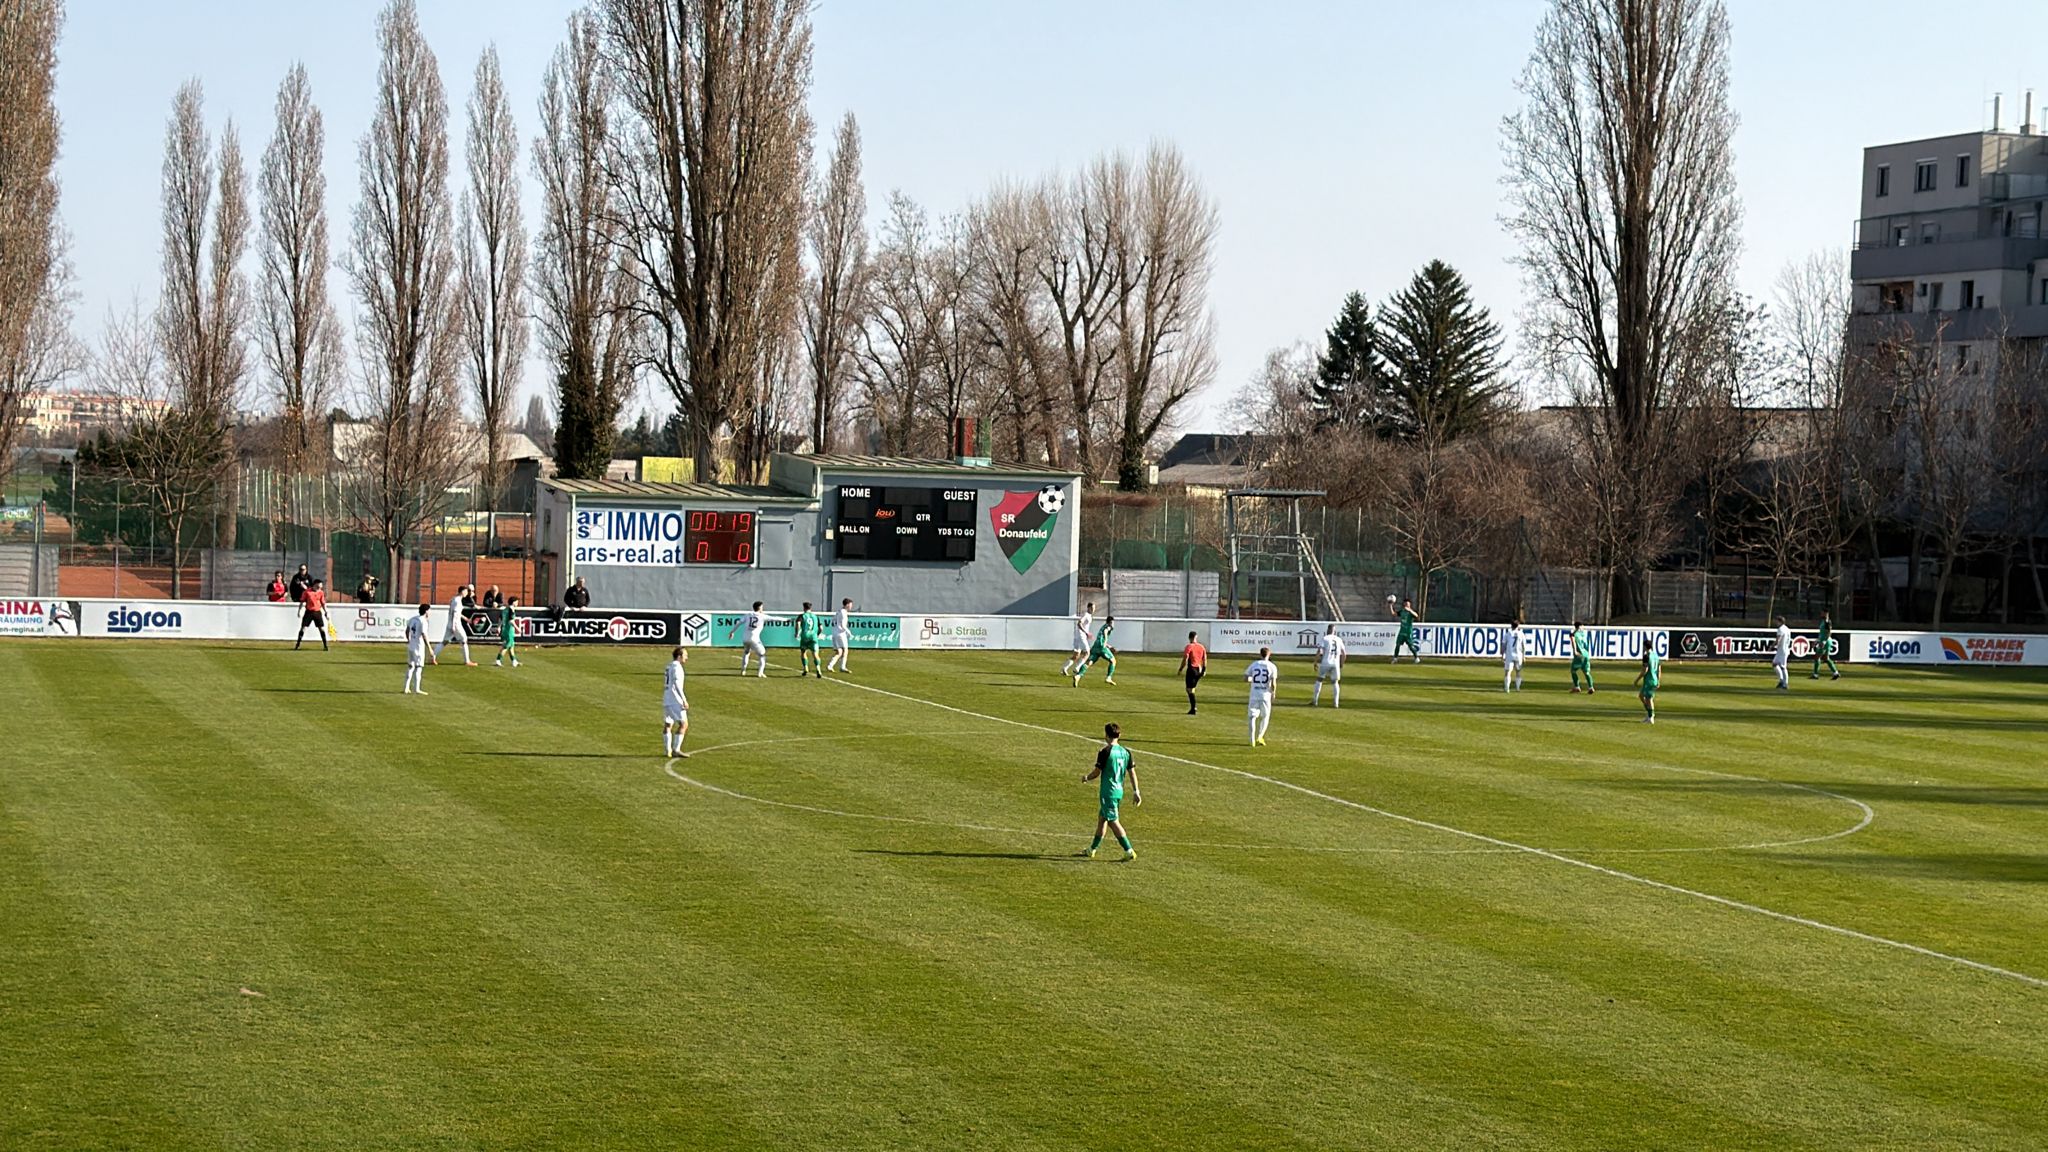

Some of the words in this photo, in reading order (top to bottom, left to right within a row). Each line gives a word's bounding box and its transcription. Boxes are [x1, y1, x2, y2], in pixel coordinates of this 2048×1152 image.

[841, 487, 871, 498] HOME
[943, 490, 976, 501] GUEST
[915, 513, 931, 522] QTR
[1000, 513, 1016, 524] SR
[607, 510, 683, 542] IMMO
[839, 525, 858, 534] BALL
[858, 526, 870, 535] ON
[896, 526, 918, 535] DOWN
[937, 528, 953, 536] YDS
[953, 528, 963, 536] TO
[963, 528, 975, 537] GO
[999, 528, 1048, 539] Donaufeld
[575, 544, 682, 564] ars-real.at
[107, 606, 182, 633] sigron
[377, 617, 391, 627] La
[748, 616, 759, 629] 12
[940, 626, 953, 636] La
[955, 626, 988, 636] Strada
[1245, 629, 1293, 637] IMMOBILIEN
[1511, 635, 1519, 648] 7
[1965, 638, 2027, 650] SRAMEK
[1868, 636, 1921, 660] sigron
[1971, 650, 2024, 662] REISEN
[1253, 668, 1269, 684] 23
